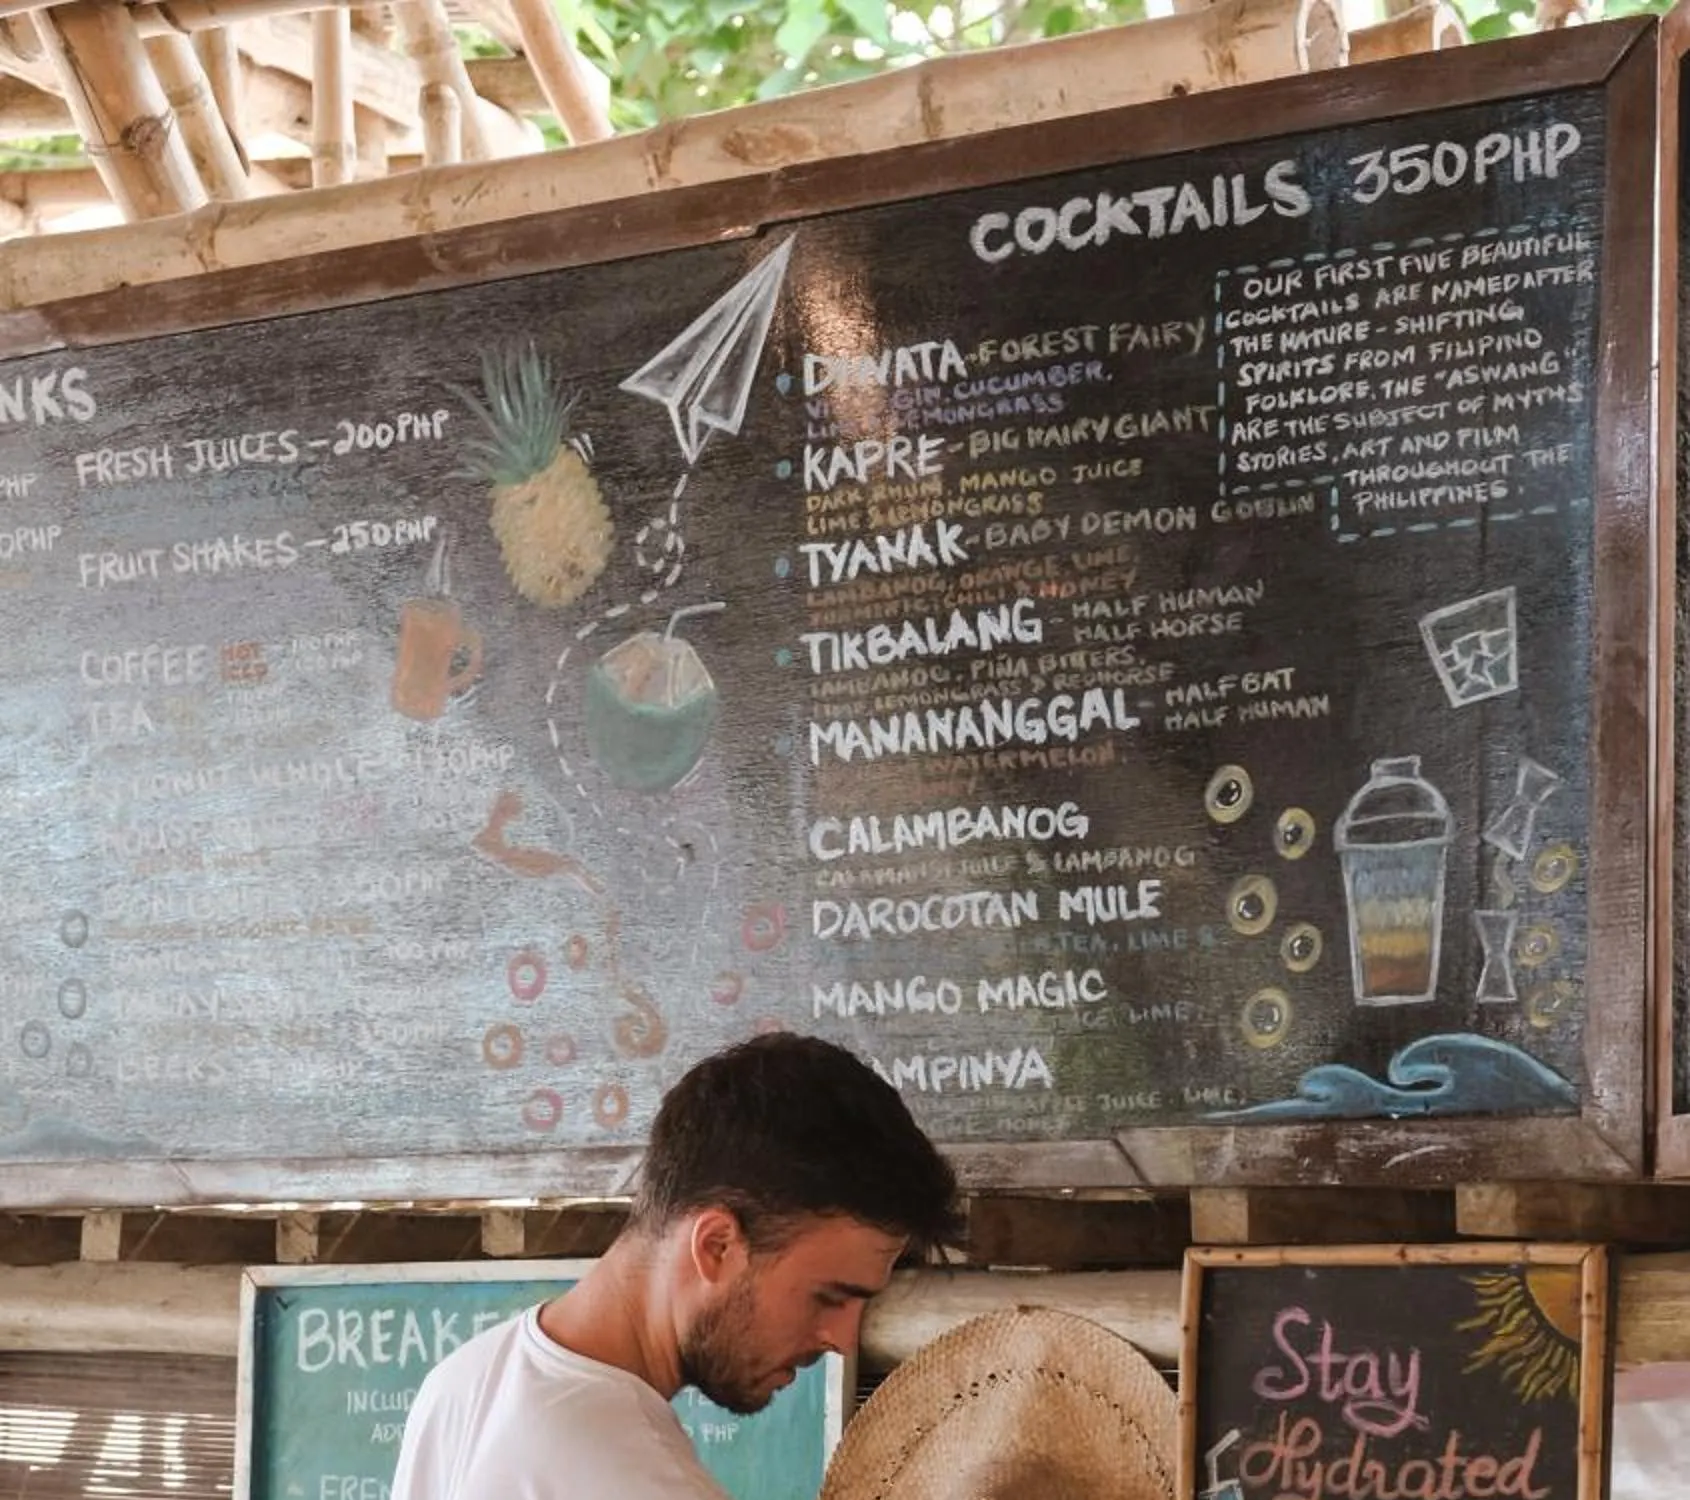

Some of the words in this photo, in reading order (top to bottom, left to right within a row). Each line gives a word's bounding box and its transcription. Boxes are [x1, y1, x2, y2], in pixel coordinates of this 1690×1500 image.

[969, 158, 1312, 263] COCKTAILS
[1243, 270, 1303, 300] OUR
[1314, 254, 1395, 290] FIRST
[1399, 249, 1455, 276] FIVE
[1461, 232, 1592, 270] BEAUTIFUL
[1224, 291, 1360, 330] COCKTAILS
[1375, 284, 1421, 309] ARE
[1229, 332, 1273, 358] THE
[1280, 321, 1371, 352] NATURE
[1394, 300, 1525, 336] SHIFTING
[978, 323, 1100, 367] FOREST
[1108, 316, 1206, 356] FAIRY
[1237, 352, 1335, 388] SPIRITS
[1344, 345, 1416, 372] FROM
[1428, 327, 1544, 362] FILIPINO
[897, 391, 1065, 432] EMONGRASS
[1231, 418, 1279, 446] ARE
[1286, 413, 1328, 438] THE
[1332, 401, 1450, 431] SUBJECT
[1456, 395, 1486, 414] OF
[1493, 382, 1584, 412] MYTHS
[1381, 374, 1428, 399] THE
[75, 443, 174, 487] FRESH
[186, 429, 300, 475] JUICES
[803, 433, 945, 492] KAPRE
[969, 428, 1020, 460] BIG
[1027, 415, 1110, 449] HAIRY
[1113, 404, 1218, 441] GIANT
[1341, 436, 1393, 460] ART
[1399, 431, 1451, 456] AND
[1456, 424, 1521, 449] FILM
[1343, 454, 1513, 486] THROUGHOUT
[1522, 443, 1574, 468] THE
[805, 487, 863, 514] DARK
[959, 466, 1058, 494] MANGO
[1072, 457, 1144, 485] JUICE
[806, 512, 862, 535] LIME
[890, 490, 1046, 528] LEMONGRASS
[79, 548, 167, 589] FRUIT
[172, 529, 300, 572] SHAKES
[799, 518, 970, 589] TYANAK
[1080, 505, 1197, 536] DEMON
[1211, 491, 1317, 524] GOBLIN
[799, 597, 1043, 676] TIKBALANG
[1072, 593, 1150, 620] HALF
[1158, 578, 1265, 614] HUMAN
[1073, 621, 1142, 643] HALF
[1151, 611, 1244, 640] HORSE
[79, 642, 209, 687] COFFEE
[809, 686, 1141, 767] MANANANGGAL
[1164, 674, 1240, 707] HALF
[1241, 666, 1296, 695] BAT
[874, 678, 1022, 711] LEMONGRASS
[1164, 705, 1230, 732] HALF
[1238, 694, 1330, 723] HUMAN
[808, 800, 1090, 863] CALAMBANOG
[1053, 844, 1195, 874] LAMBANOG
[811, 889, 1039, 941] DAROCOTAN
[1058, 878, 1163, 926] MULE
[1128, 927, 1188, 952] LIME
[811, 974, 963, 1019] MANGO
[976, 968, 1109, 1015] MAGIC
[1252, 1304, 1430, 1437] Stay
